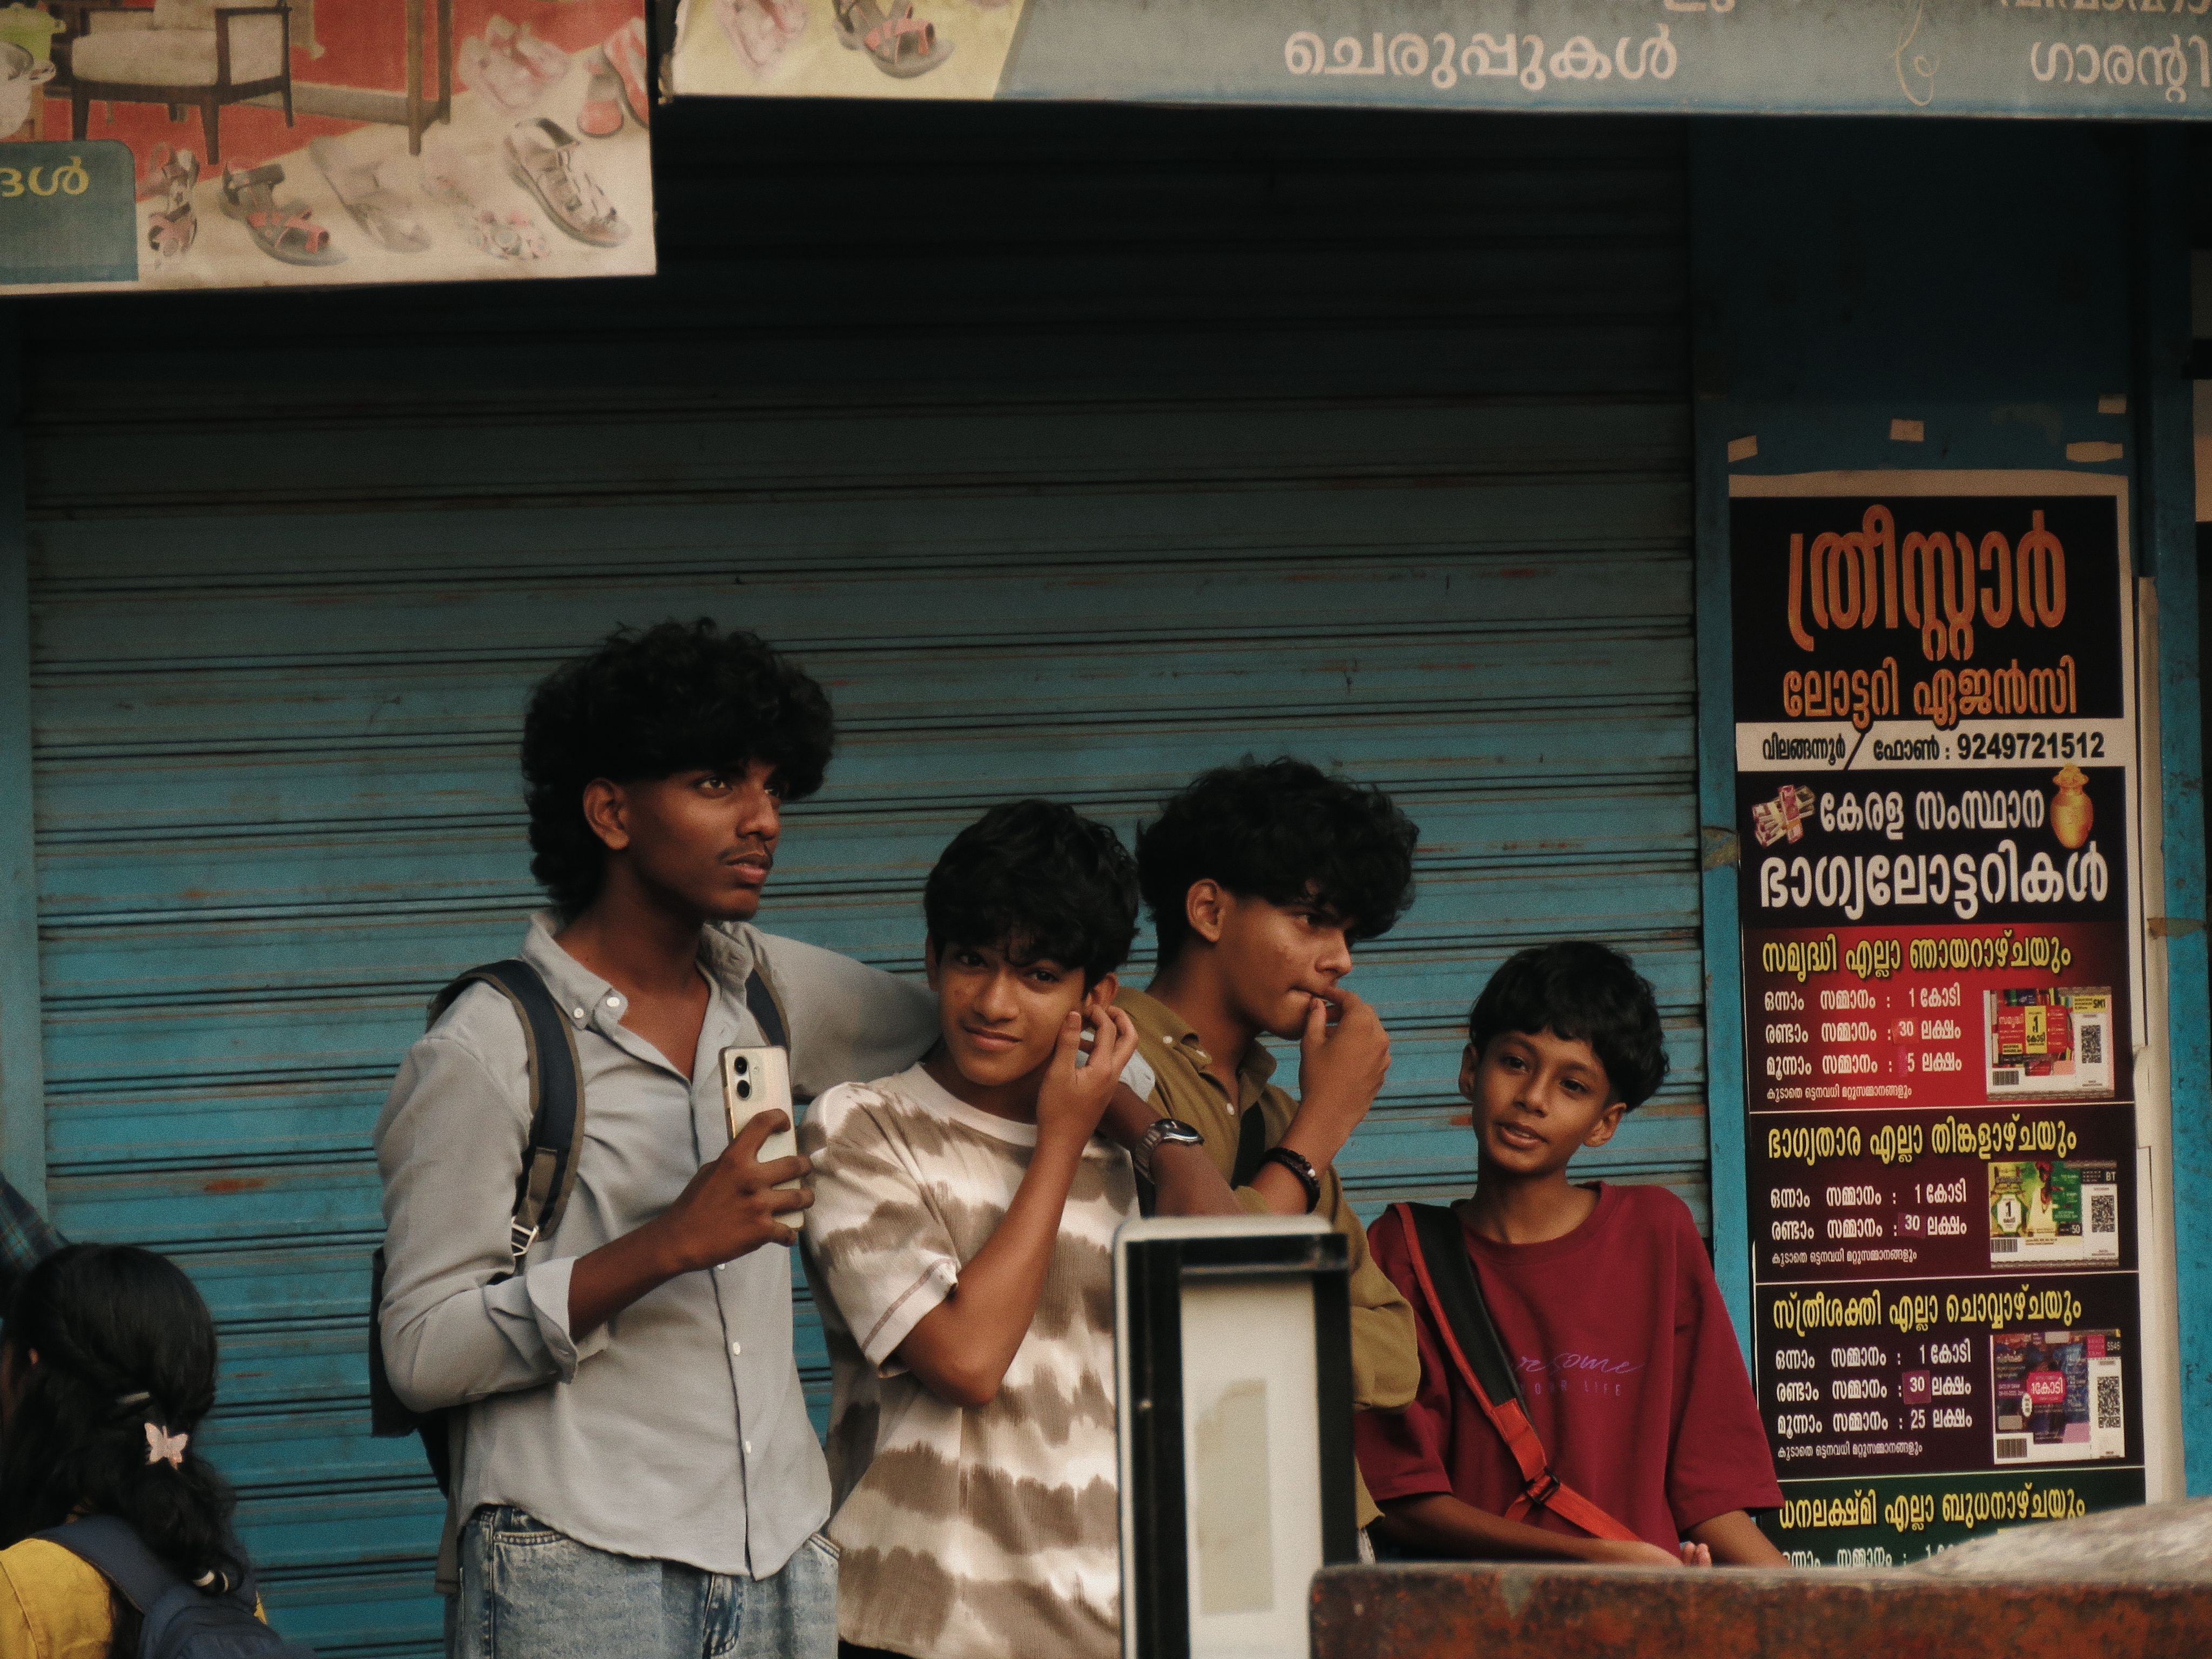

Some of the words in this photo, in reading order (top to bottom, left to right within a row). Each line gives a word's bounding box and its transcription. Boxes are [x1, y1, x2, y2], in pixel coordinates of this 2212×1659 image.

[1284, 23, 1678, 90] ചെരുപ്പുകൾ
[1788, 504, 2066, 661] ത്രീസ്റ്റാർ
[1783, 656, 1899, 729] ലോട്ടറി
[1914, 655, 2076, 727] ഏജൻസി
[1873, 734, 1940, 760] ഫോൺ
[1957, 732, 2105, 760] 9249721512
[1820, 789, 1904, 840] കേരള
[1916, 788, 2045, 831] സംസ്ഥാന
[1761, 839, 2108, 921] ഭാഗ്യലോട്ടറികൾ
[1846, 940, 1901, 979] എല്ലാ
[1764, 991, 1805, 1011] ഒന്നാം
[1820, 989, 1876, 1010] സമ്മാനം
[1909, 988, 1914, 1008] 1
[1920, 982, 1961, 1008] കോടി
[1765, 1023, 1809, 1044] രണ്ടാം
[1821, 1021, 1877, 1042] സമ്മാനം
[1898, 1021, 1914, 1037] 30
[1921, 1020, 1961, 1040] ലക്ഷം
[1766, 1056, 1812, 1081] മൂന്നാം
[1822, 1054, 1878, 1074] സമ്മാനം
[1907, 1053, 1915, 1073] 5
[1921, 1052, 1963, 1072] ലക്ഷം
[1769, 1126, 1861, 1166] ഭാഗ്യതാര
[1870, 1124, 1923, 1164] എല്ലാ
[1771, 1188, 1810, 1209] ഒന്നാം
[1826, 1185, 1882, 1206] സമ്മാനം
[1915, 1184, 1920, 1204] 1
[1926, 1178, 1966, 1204] കോടി
[1772, 1220, 1815, 1240] രണ്ടാം
[1827, 1218, 1883, 1238] സമ്മാനം
[1905, 1214, 1920, 1231] 30
[1927, 1216, 1967, 1236] ലക്ഷം
[1773, 1289, 1881, 1337] സ്ത്രീശക്തി
[1890, 1295, 1938, 1333] എല്ലാ
[1776, 1350, 1815, 1370] ഒന്നാം
[1831, 1346, 1886, 1367] സമ്മാനം
[1919, 1345, 1925, 1365] 1
[1931, 1338, 1971, 1365] കോടി
[1777, 1382, 1819, 1402] രണ്ടാം
[1832, 1379, 1887, 1400] സമ്മാനം
[1909, 1376, 1925, 1392] 30
[1932, 1376, 1972, 1396] ലക്ഷം
[1778, 1414, 1823, 1439] മൂന്നാം
[1833, 1411, 1889, 1432] സമ്മാനം
[1911, 1409, 1926, 1431] 25
[1933, 1408, 1972, 1428] ലക്ഷം
[1885, 1494, 1934, 1533] എല്ലാ
